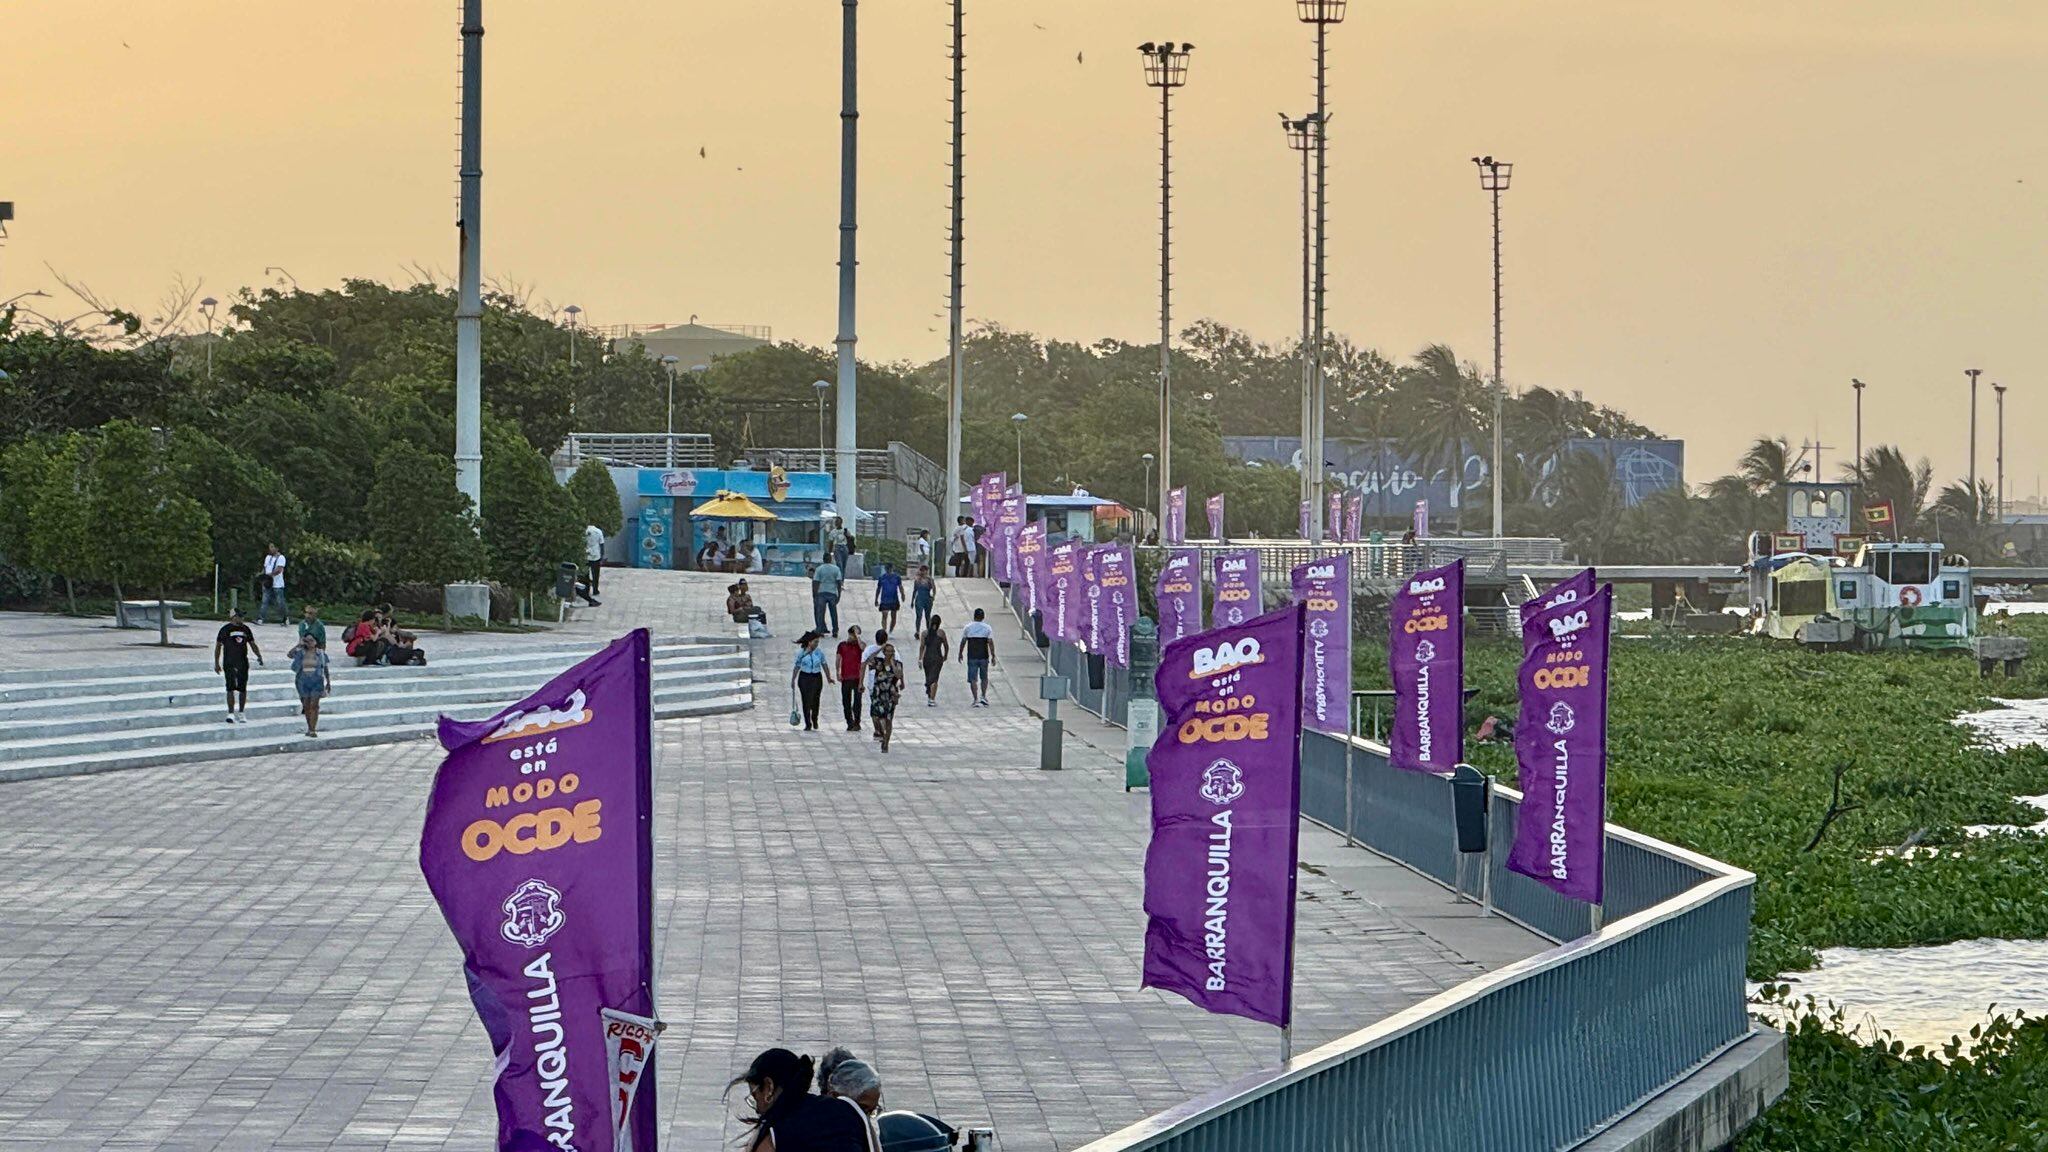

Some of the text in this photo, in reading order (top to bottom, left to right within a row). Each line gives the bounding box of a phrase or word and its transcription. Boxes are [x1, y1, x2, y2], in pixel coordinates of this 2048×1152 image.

[1410, 577, 1444, 594] BAQ
[1193, 637, 1261, 675] BAQ
[1546, 650, 1583, 663] MODO
[1533, 665, 1590, 689] OCDE
[1195, 694, 1255, 713] MODO
[1417, 665, 1431, 761] BARRANQUILLA
[1178, 712, 1269, 744] OCDE
[509, 737, 557, 761] está
[520, 760, 546, 774] en
[486, 773, 579, 808] MODO
[1550, 739, 1569, 880] BARRANQUILLA
[461, 799, 602, 861] OCDE
[1205, 809, 1233, 991] BARRANQUILLA
[524, 952, 578, 1152] RANQUILLA
